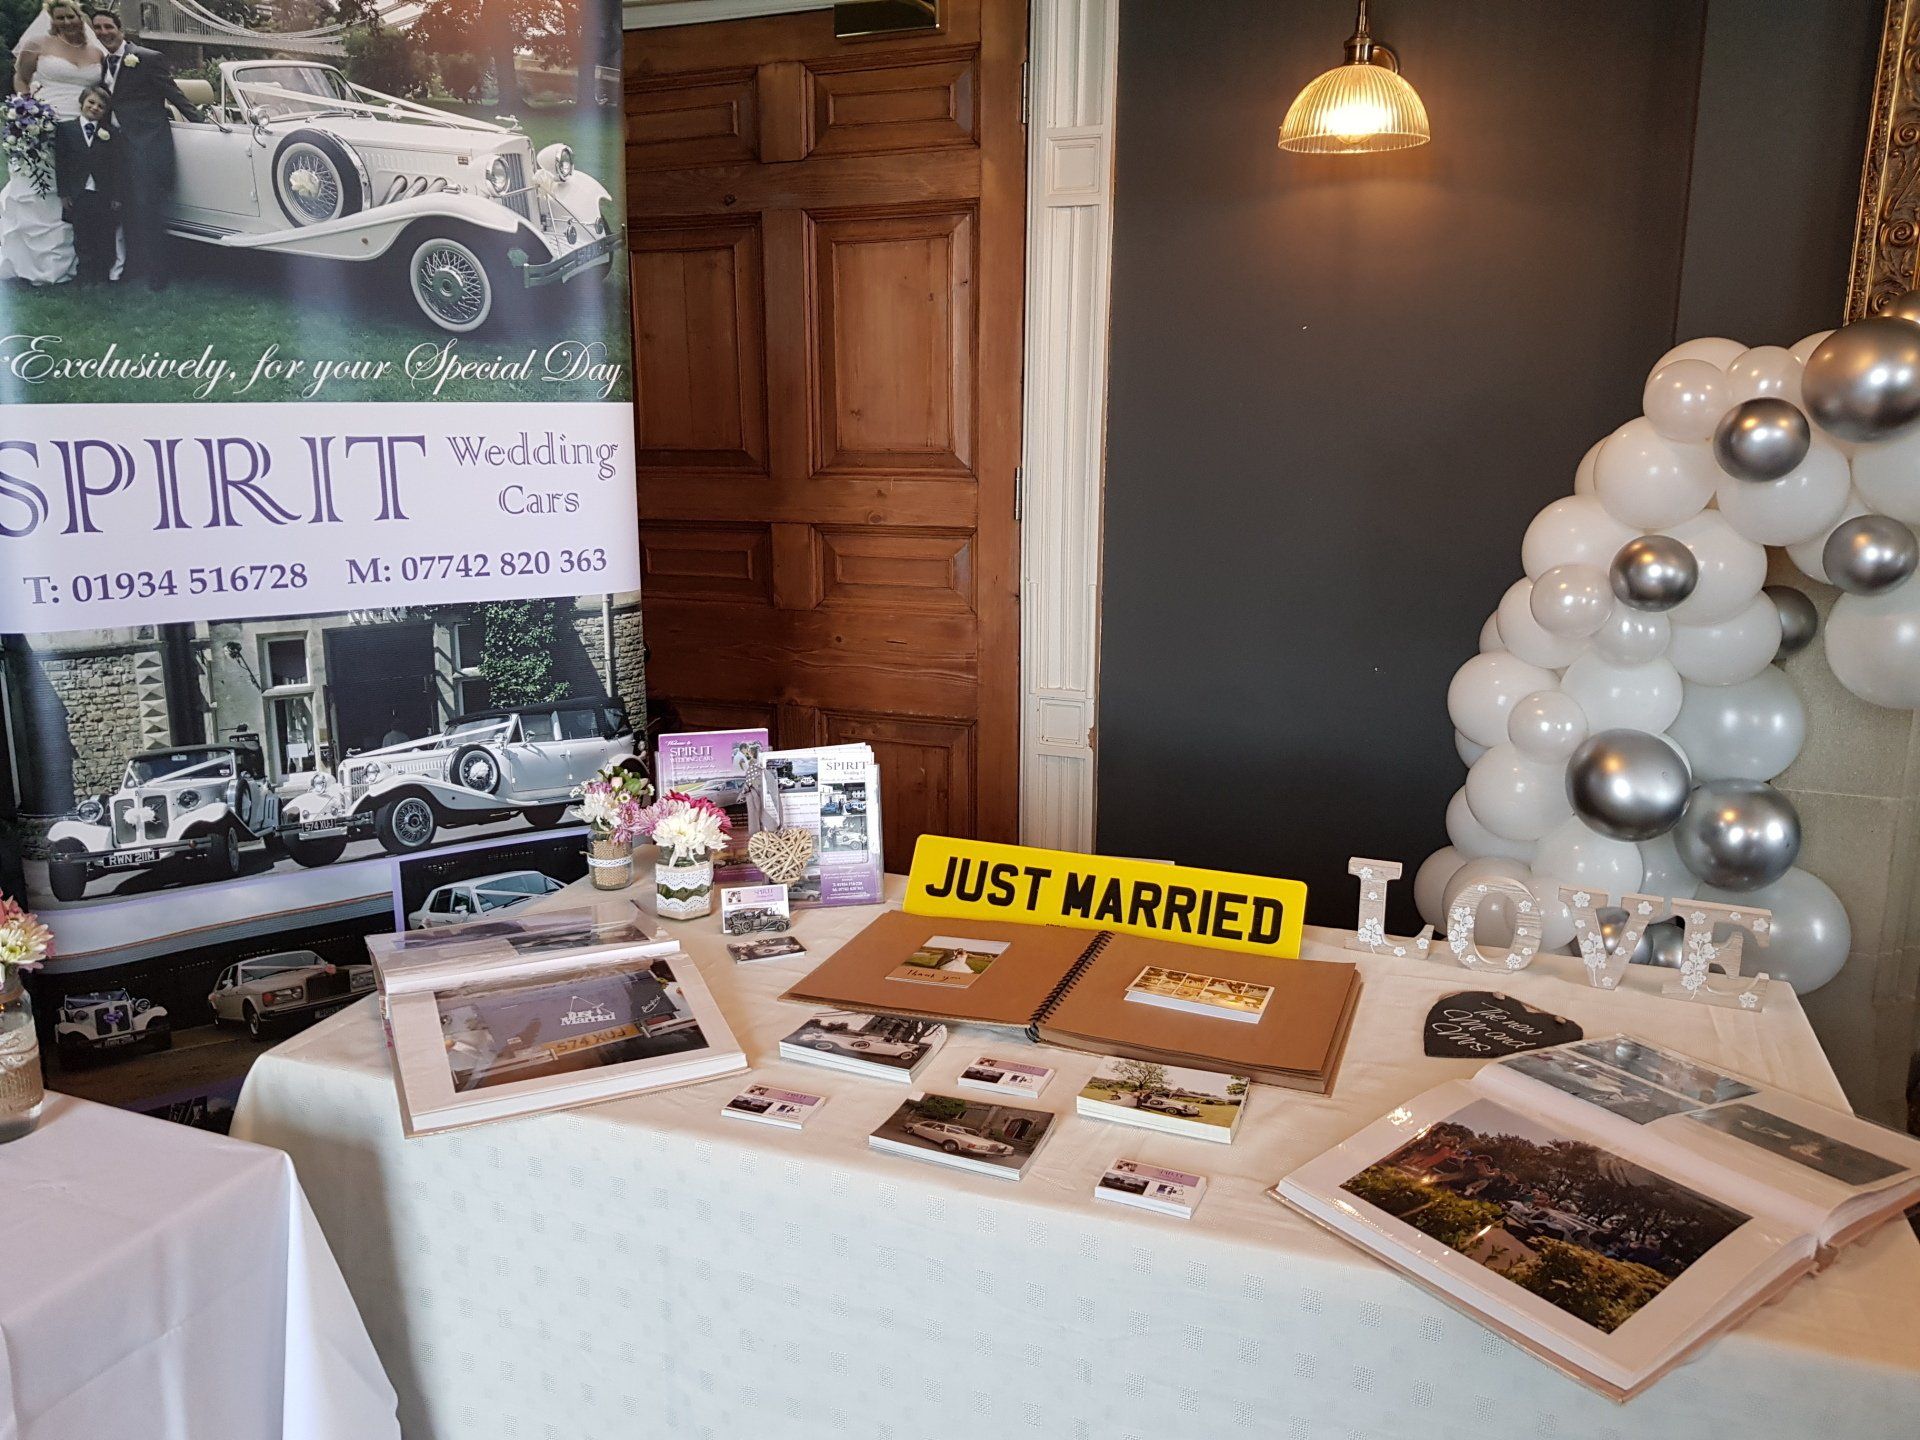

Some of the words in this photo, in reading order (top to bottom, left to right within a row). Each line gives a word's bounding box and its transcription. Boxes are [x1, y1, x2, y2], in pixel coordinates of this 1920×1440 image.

[0, 335, 236, 399] Exclusively,
[233, 343, 306, 395] for
[301, 360, 393, 399] your
[404, 338, 536, 396] Special
[540, 340, 623, 399] Day
[446, 431, 619, 481] Wedding
[0, 434, 426, 538] SPIRIT
[499, 485, 580, 515] Cars
[23, 575, 60, 605] T:
[71, 569, 179, 603] 01934
[188, 562, 309, 595] 516728
[346, 557, 392, 585] M:
[401, 553, 491, 582] 07742
[500, 550, 551, 576] 820
[560, 548, 608, 573] 363
[669, 745, 713, 757] SPIRIT
[109, 854, 133, 866] RWN
[925, 856, 1052, 911] JUST
[1060, 872, 1284, 945] MARRIED
[1342, 856, 1773, 1013] LOVE
[1473, 1001, 1511, 1021] The
